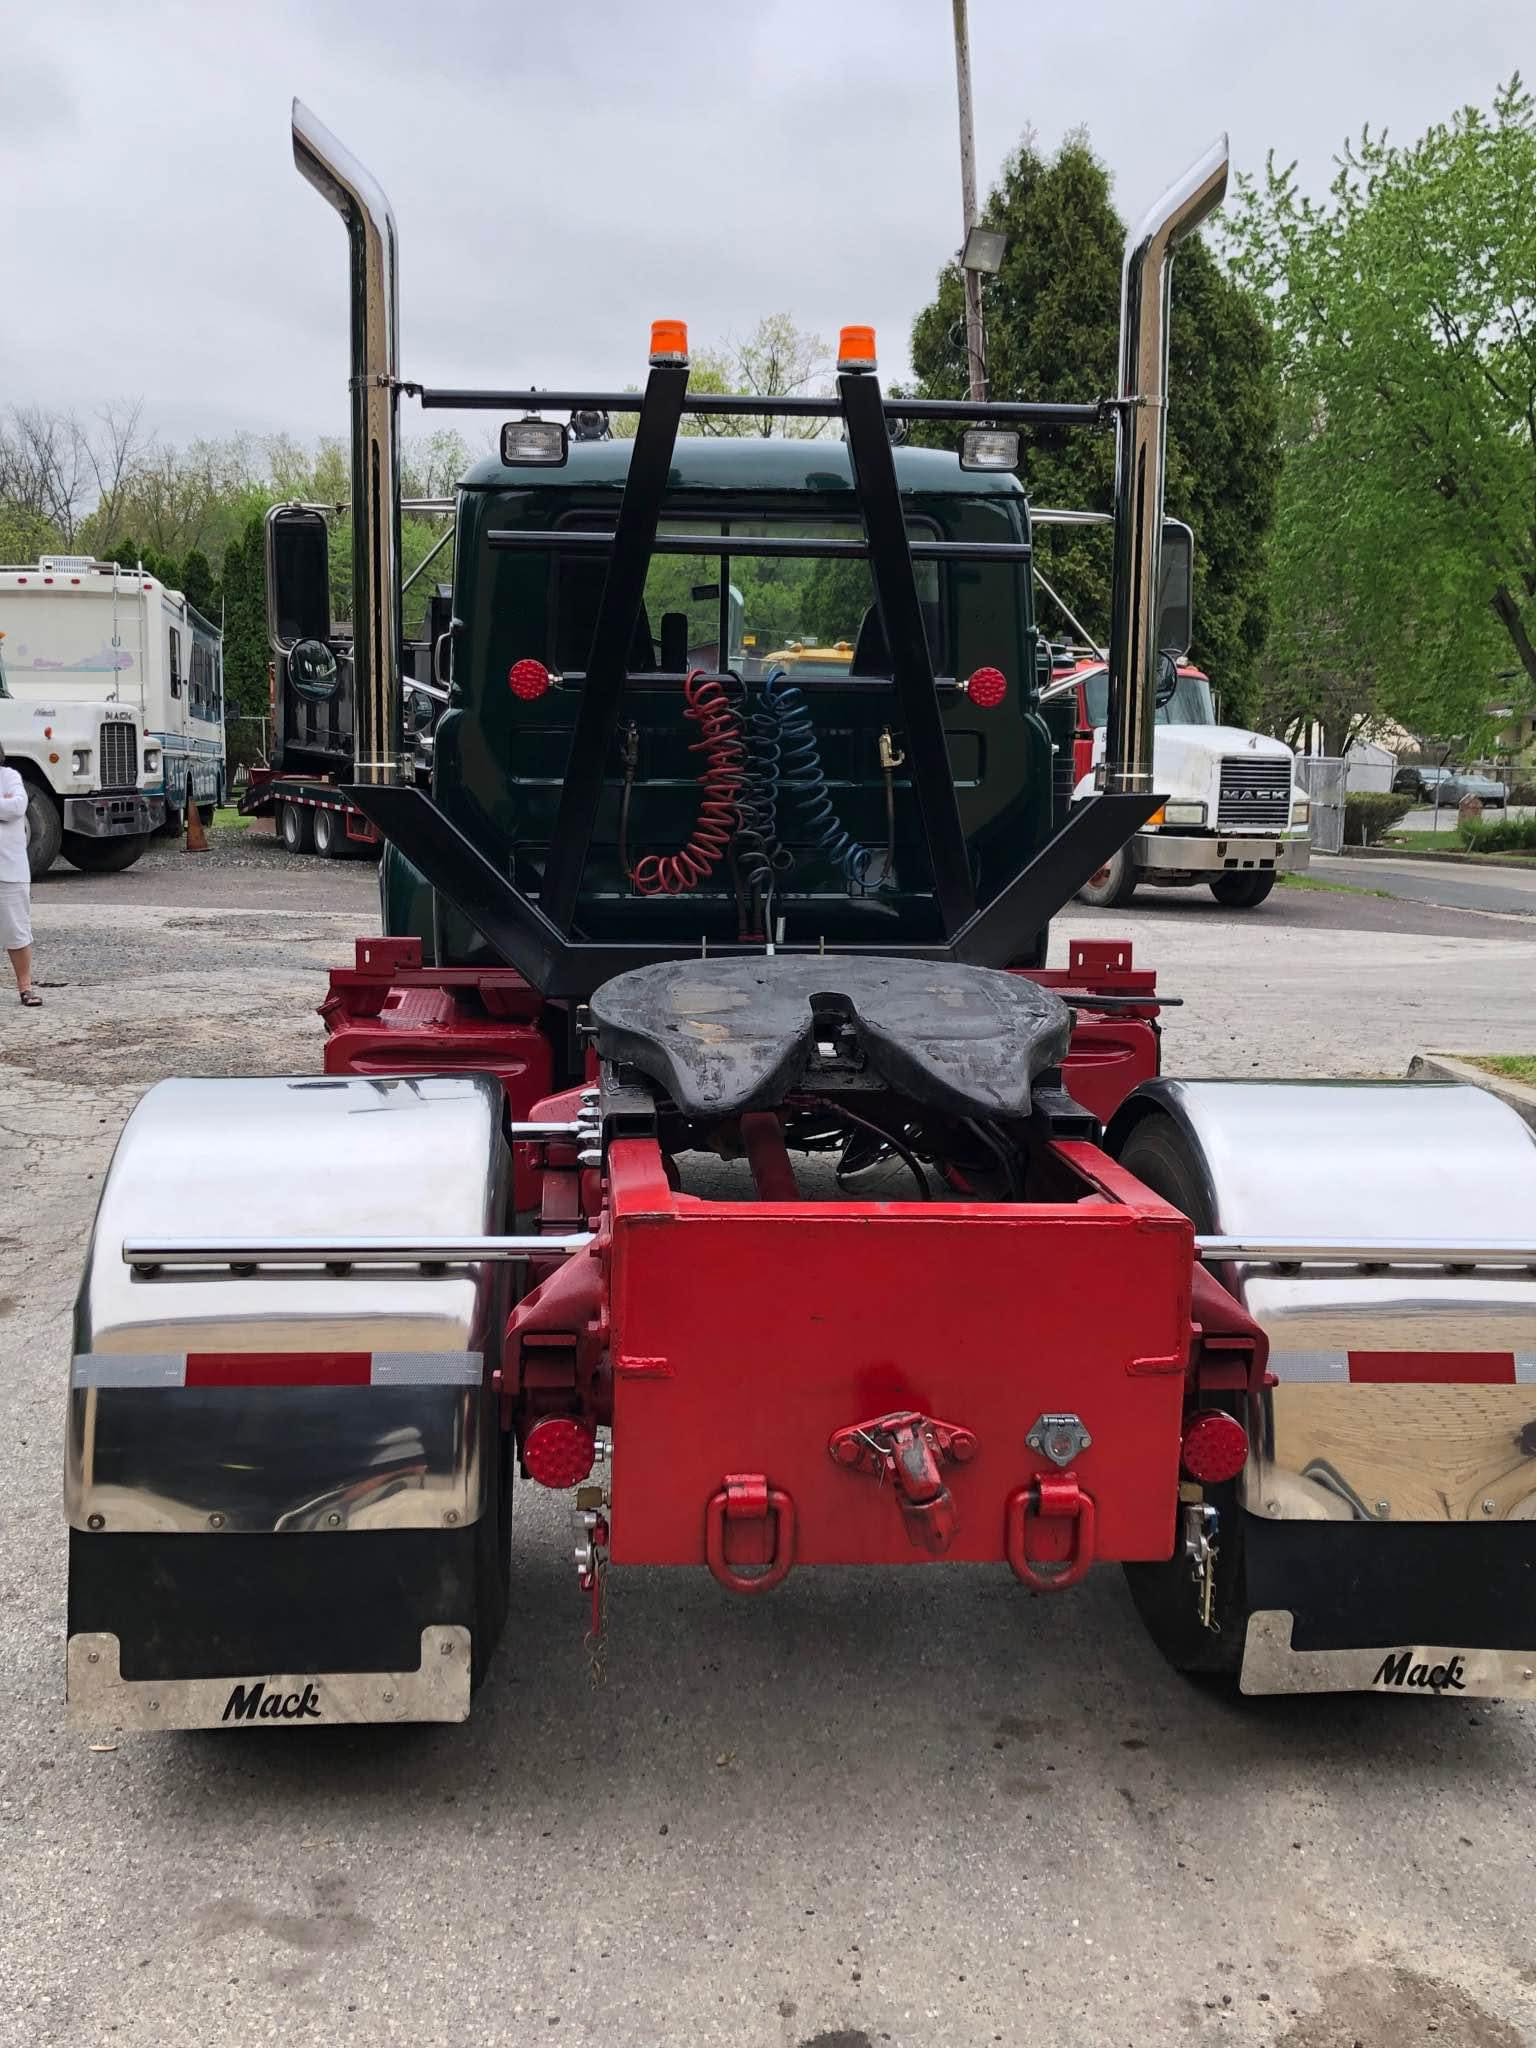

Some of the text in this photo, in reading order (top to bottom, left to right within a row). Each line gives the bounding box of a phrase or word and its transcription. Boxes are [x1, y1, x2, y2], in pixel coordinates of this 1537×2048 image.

[1222, 790, 1287, 800] MACK
[1372, 1651, 1466, 1690] Mack
[221, 1683, 321, 1721] Mack
